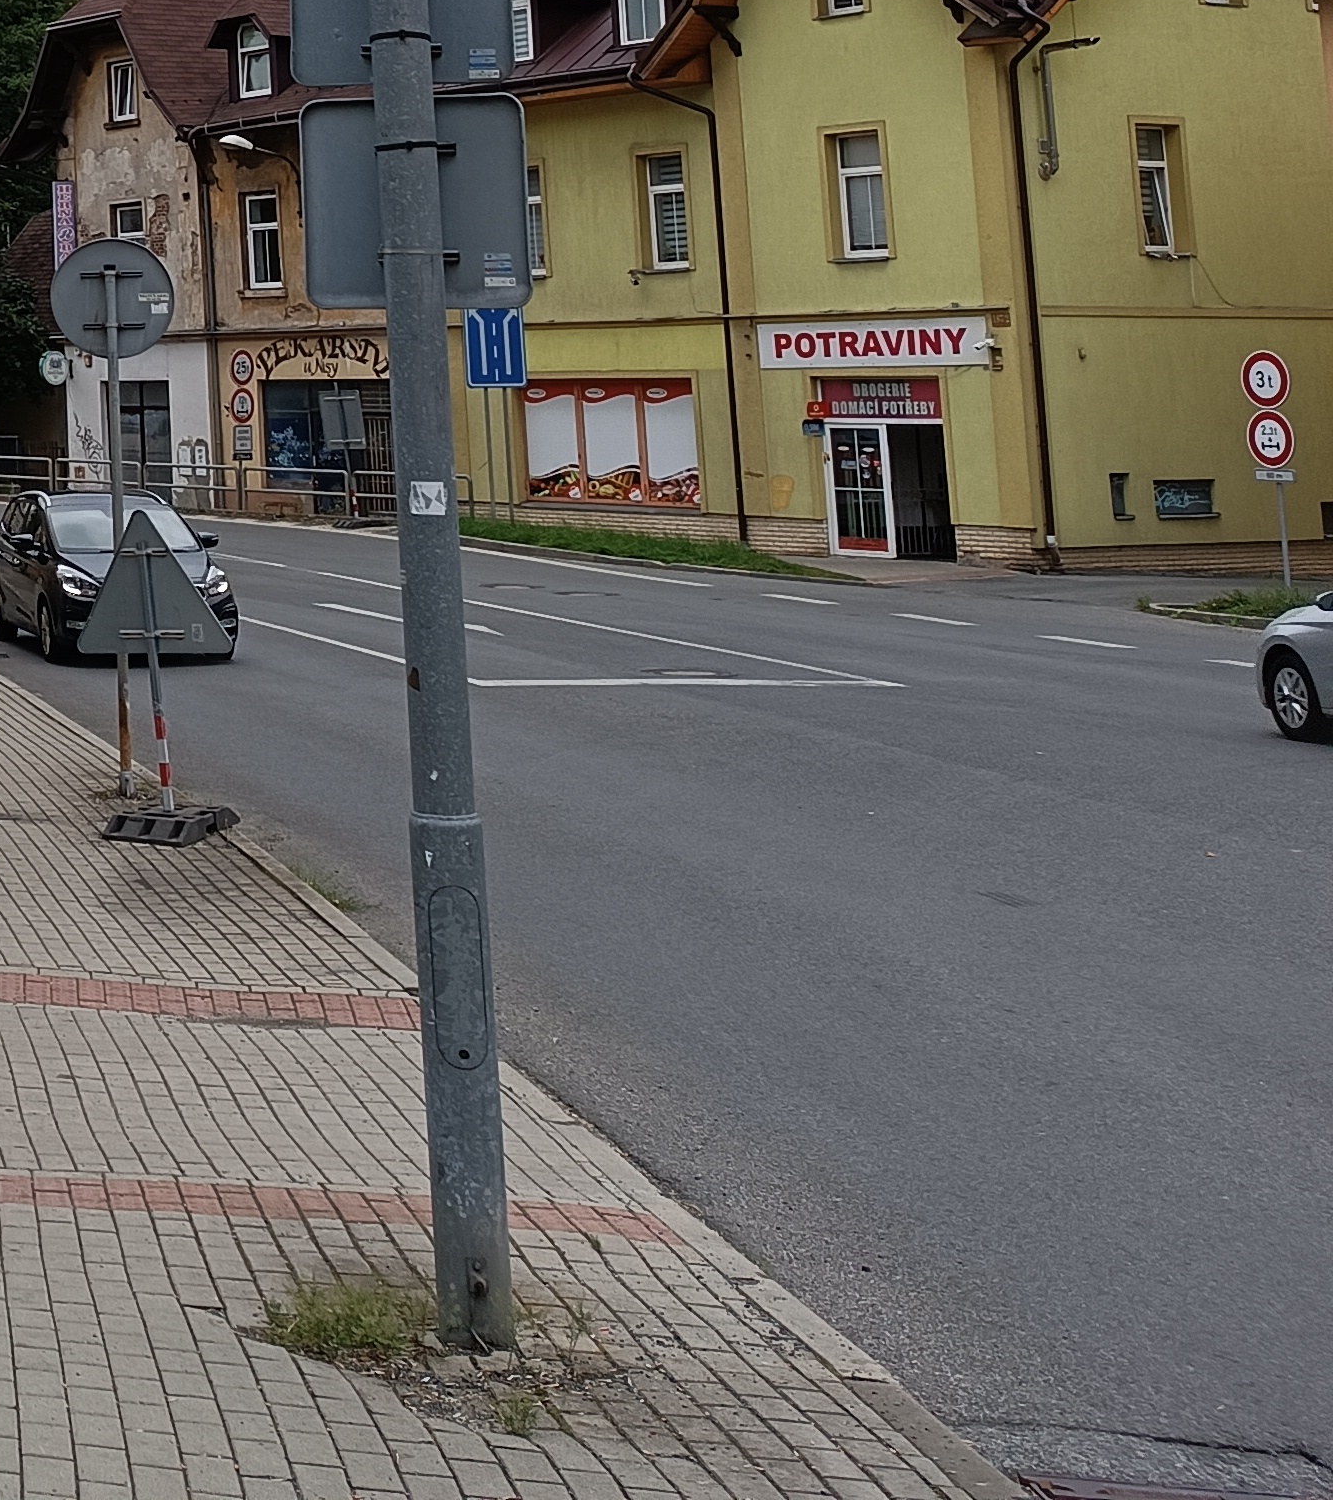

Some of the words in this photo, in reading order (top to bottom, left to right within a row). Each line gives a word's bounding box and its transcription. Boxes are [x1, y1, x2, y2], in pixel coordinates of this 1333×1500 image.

[773, 328, 967, 359] POTRAVINY
[852, 382, 911, 397] DROGERIE
[832, 398, 879, 415] DOMÁCÍ
[882, 398, 935, 415] POTŘEBY
